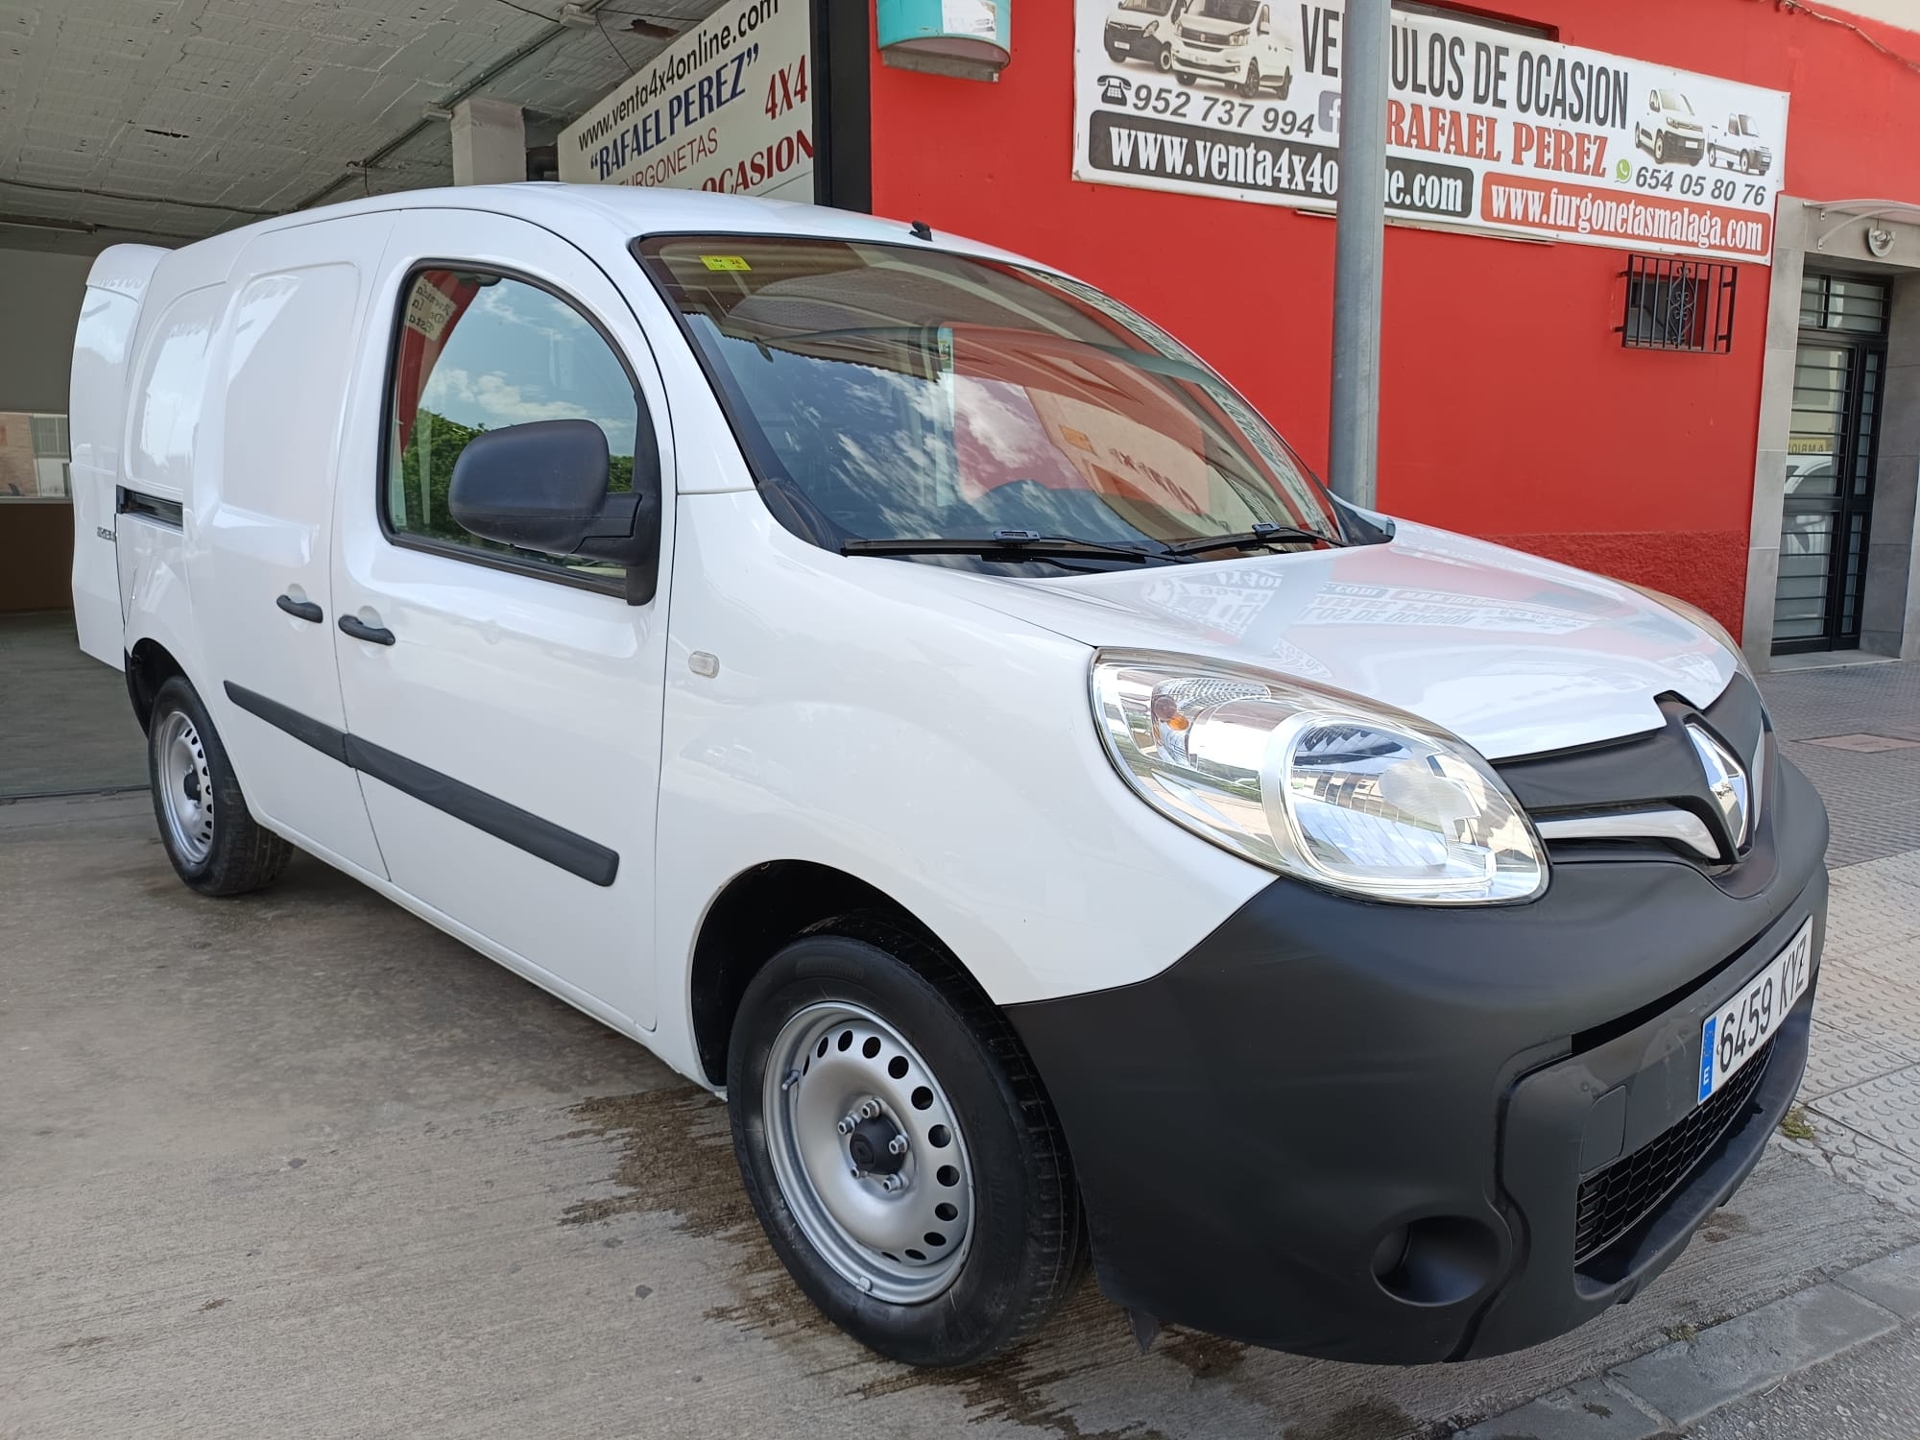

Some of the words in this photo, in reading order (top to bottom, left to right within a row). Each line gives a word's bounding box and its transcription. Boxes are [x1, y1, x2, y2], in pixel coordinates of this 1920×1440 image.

[578, 0, 778, 151] www.venta4x4online.com
[1301, 4, 1465, 101] VEULOS
[1473, 41, 1509, 109] DE
[1517, 50, 1629, 130] OCASION
[1132, 84, 1191, 118] 952
[1201, 96, 1254, 129] 737
[1262, 107, 1315, 138] 994
[1386, 99, 1501, 162] RAFAEL
[1511, 121, 1608, 178] PEREZ
[620, 127, 718, 187] RGONETAS
[1109, 126, 1463, 212] www.venta4x4oe.com
[1635, 166, 1673, 191] 654
[1679, 173, 1706, 196] 05
[1711, 178, 1736, 201] 80
[1743, 182, 1767, 206] 76
[1491, 184, 1763, 251] www.furgonetasmalaga.com
[1719, 976, 1773, 1073] 6459
[1779, 934, 1807, 1016] KYZ
[1703, 1065, 1711, 1085] E
